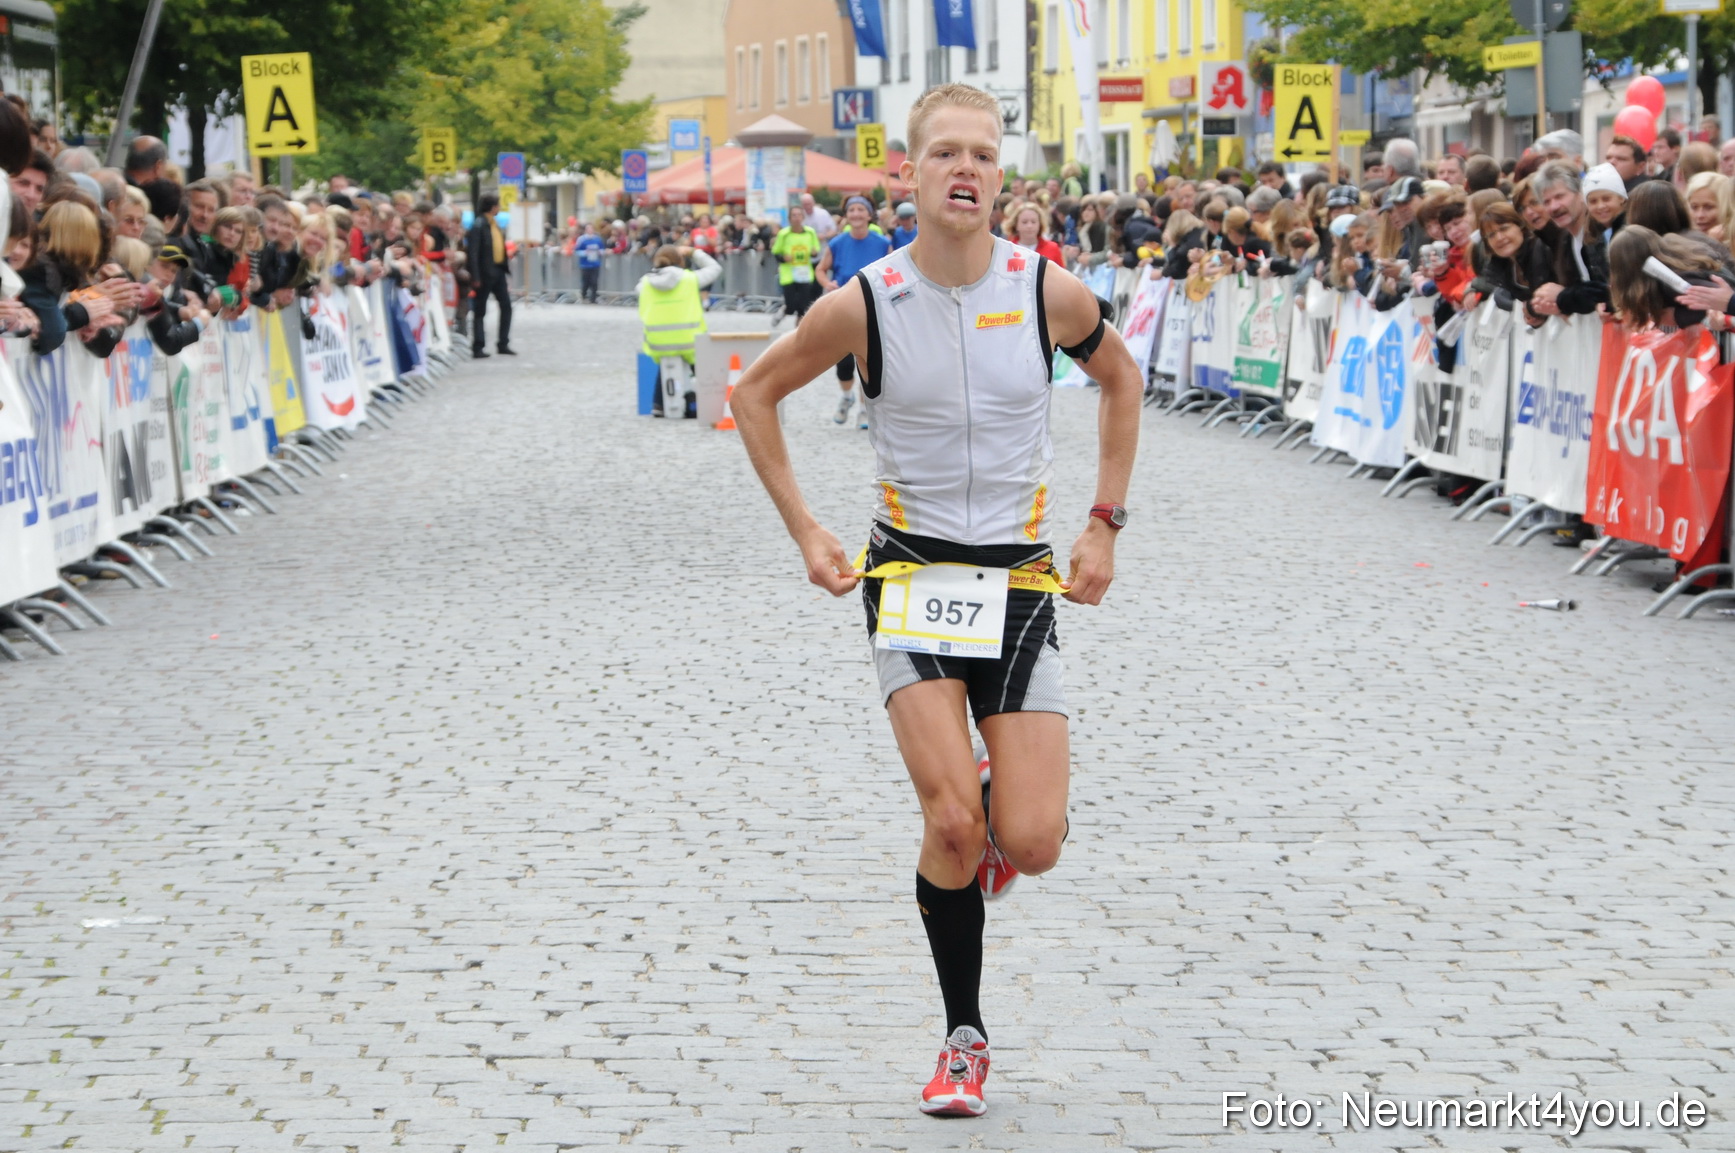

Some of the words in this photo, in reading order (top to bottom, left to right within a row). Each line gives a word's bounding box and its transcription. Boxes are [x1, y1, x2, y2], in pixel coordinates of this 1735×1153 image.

[1497, 50, 1533, 61] Toiletten
[250, 57, 301, 78] Block
[1283, 68, 1332, 86] Block
[264, 85, 299, 132] A
[1288, 95, 1323, 140] A
[432, 142, 447, 163] B
[865, 138, 880, 158] B
[1008, 574, 1044, 585] owerBar
[925, 597, 984, 627] 957
[952, 642, 999, 652] PFLEIDERER
